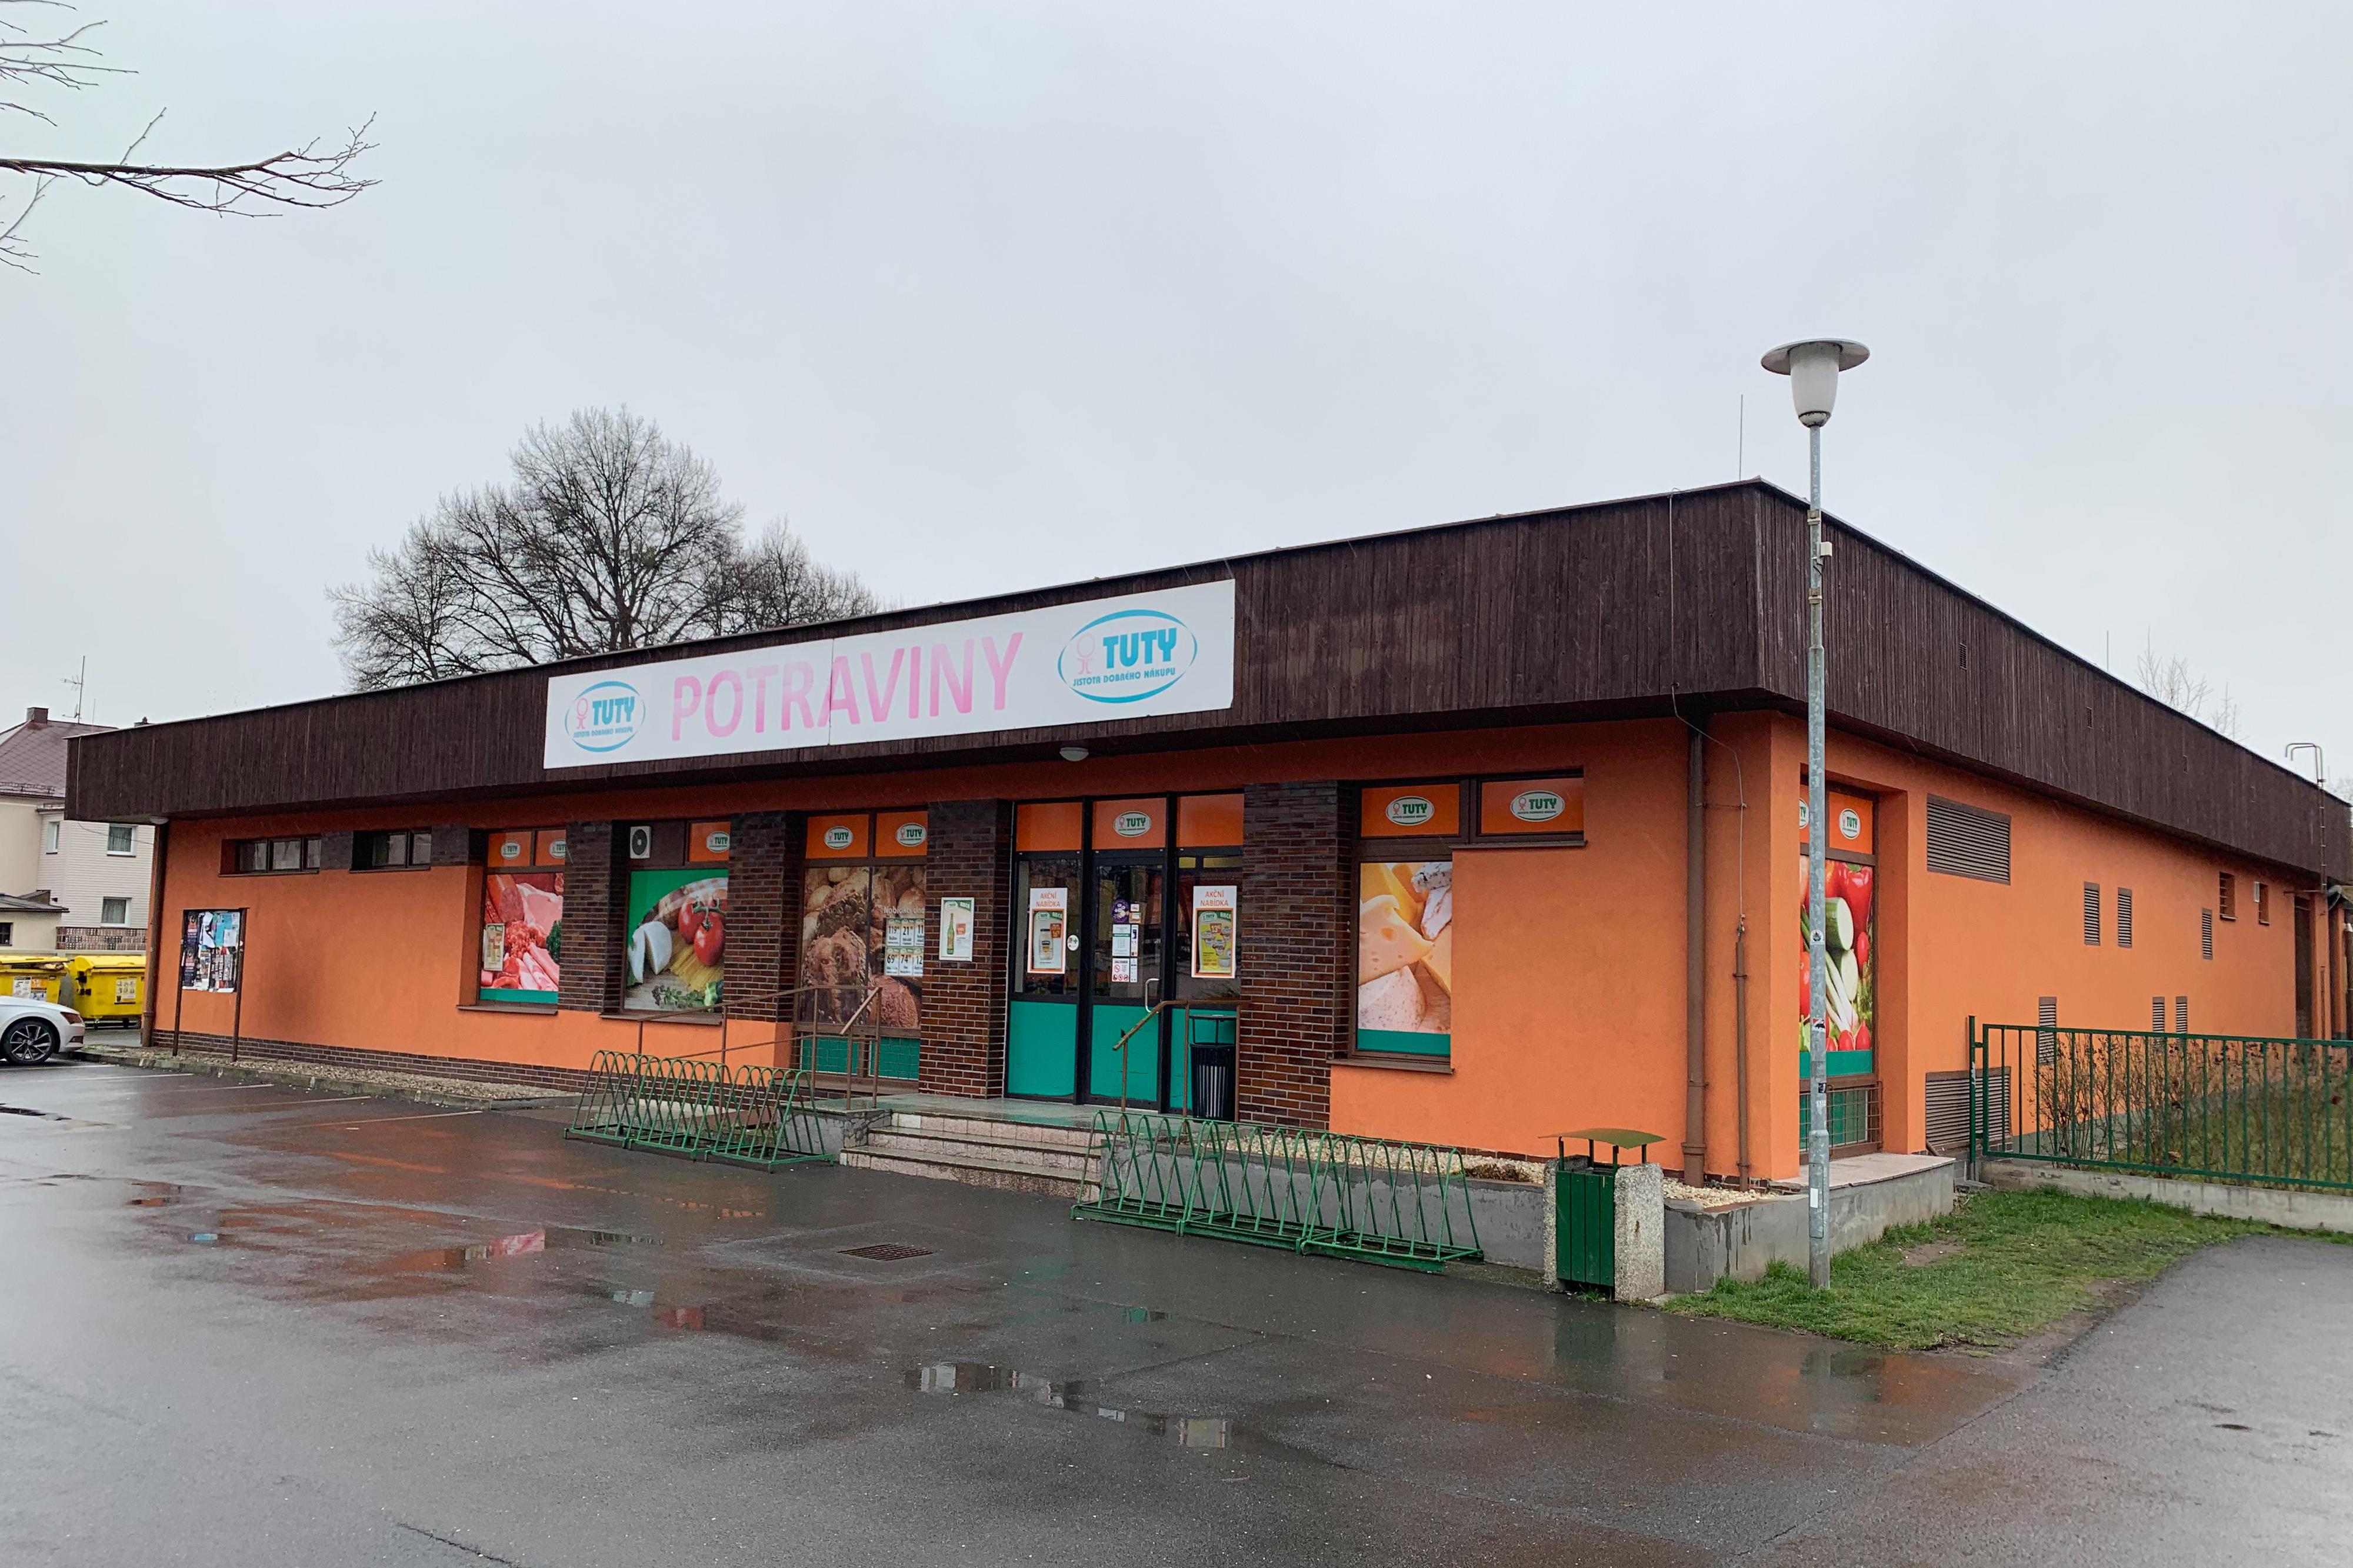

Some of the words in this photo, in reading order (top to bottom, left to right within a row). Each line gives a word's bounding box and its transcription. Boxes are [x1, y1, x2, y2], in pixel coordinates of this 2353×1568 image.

[1103, 627, 1177, 669] TUTY
[1072, 676, 1101, 686] JISTOTA
[1103, 670, 1141, 683] DOBRÉHO
[1144, 668, 1176, 678] NÁKUPU
[672, 632, 1024, 740] POTRAVINY
[592, 696, 635, 726] TUTY
[1402, 803, 1428, 815] TUTY
[1529, 798, 1557, 810] TUTY
[1126, 817, 1146, 827] TUTY
[1847, 816, 1858, 829] TUTY
[834, 832, 849, 840] TUTY
[906, 829, 922, 838] TUTY
[1204, 889, 1224, 898] AKČNÍ
[1200, 898, 1229, 906] NABÍDKA
[902, 926, 909, 935] 21
[886, 954, 895, 963] 69
[901, 954, 908, 963] 74
